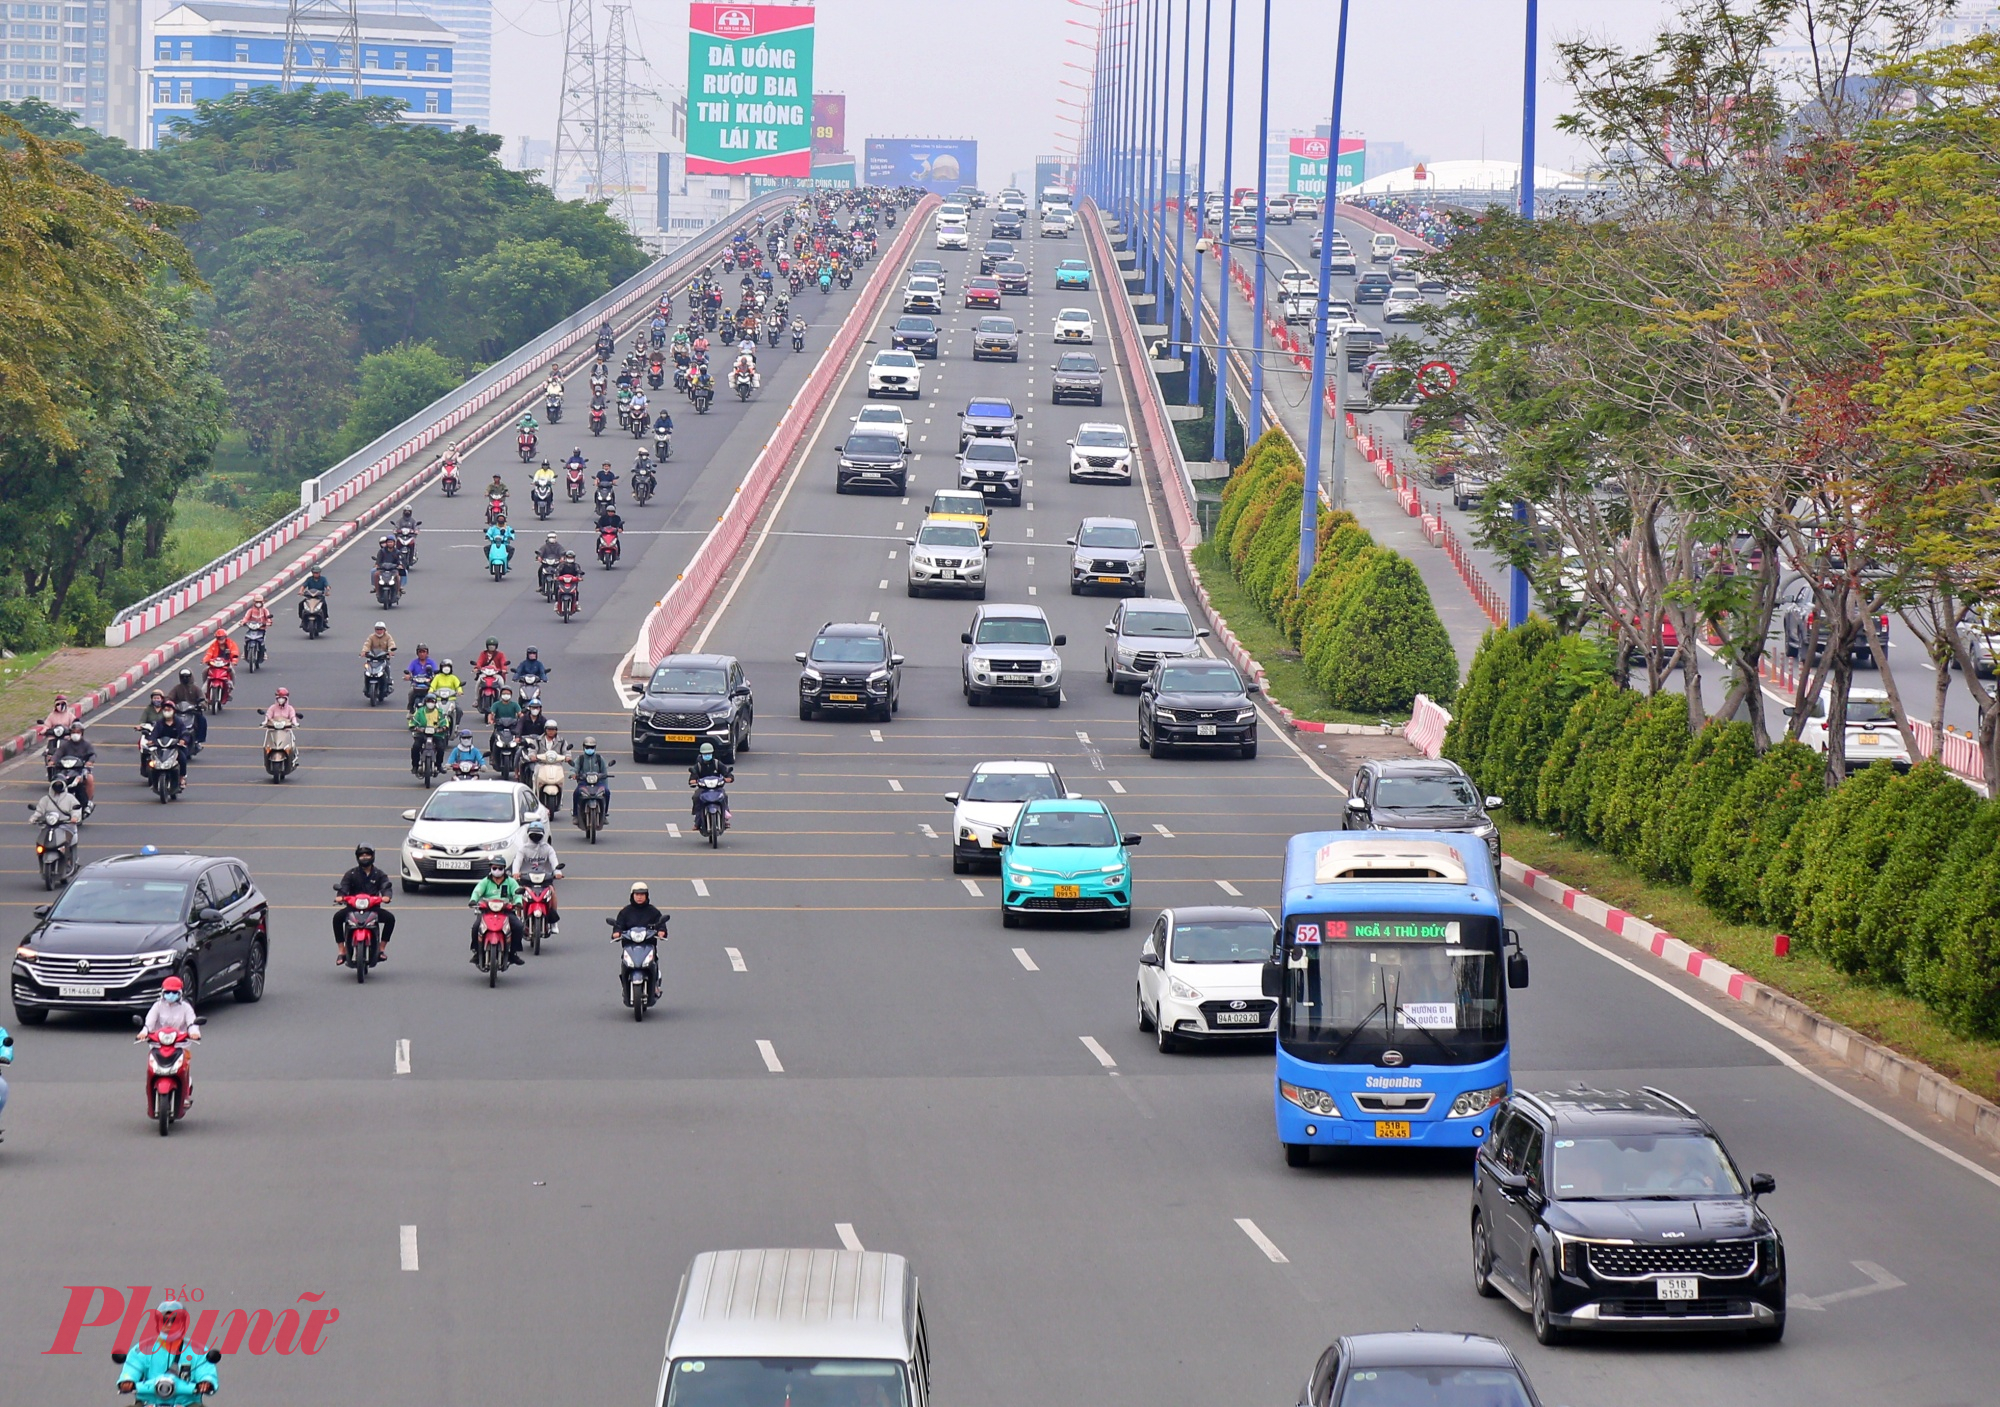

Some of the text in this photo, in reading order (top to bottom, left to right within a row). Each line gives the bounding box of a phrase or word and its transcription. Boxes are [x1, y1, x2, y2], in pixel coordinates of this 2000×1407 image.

[708, 42, 795, 69] ĐÃ UỐNG
[703, 72, 798, 98] RƯỢU BIA
[697, 100, 803, 125] THÌ KHÔNG
[720, 126, 778, 150] LÁI XE
[817, 126, 833, 138] 89
[1320, 163, 1352, 177] UNG
[1298, 926, 1318, 942] 52
[1327, 921, 1347, 938] 52
[1355, 923, 1380, 937] NGÃ
[1383, 926, 1390, 937] 4
[1394, 923, 1418, 937] THỦ
[1440, 1016, 1454, 1024] GIA
[1366, 1076, 1422, 1089] SaigonBus
[1669, 1280, 1687, 1289] 51B
[1662, 1290, 1694, 1299] 515.73
